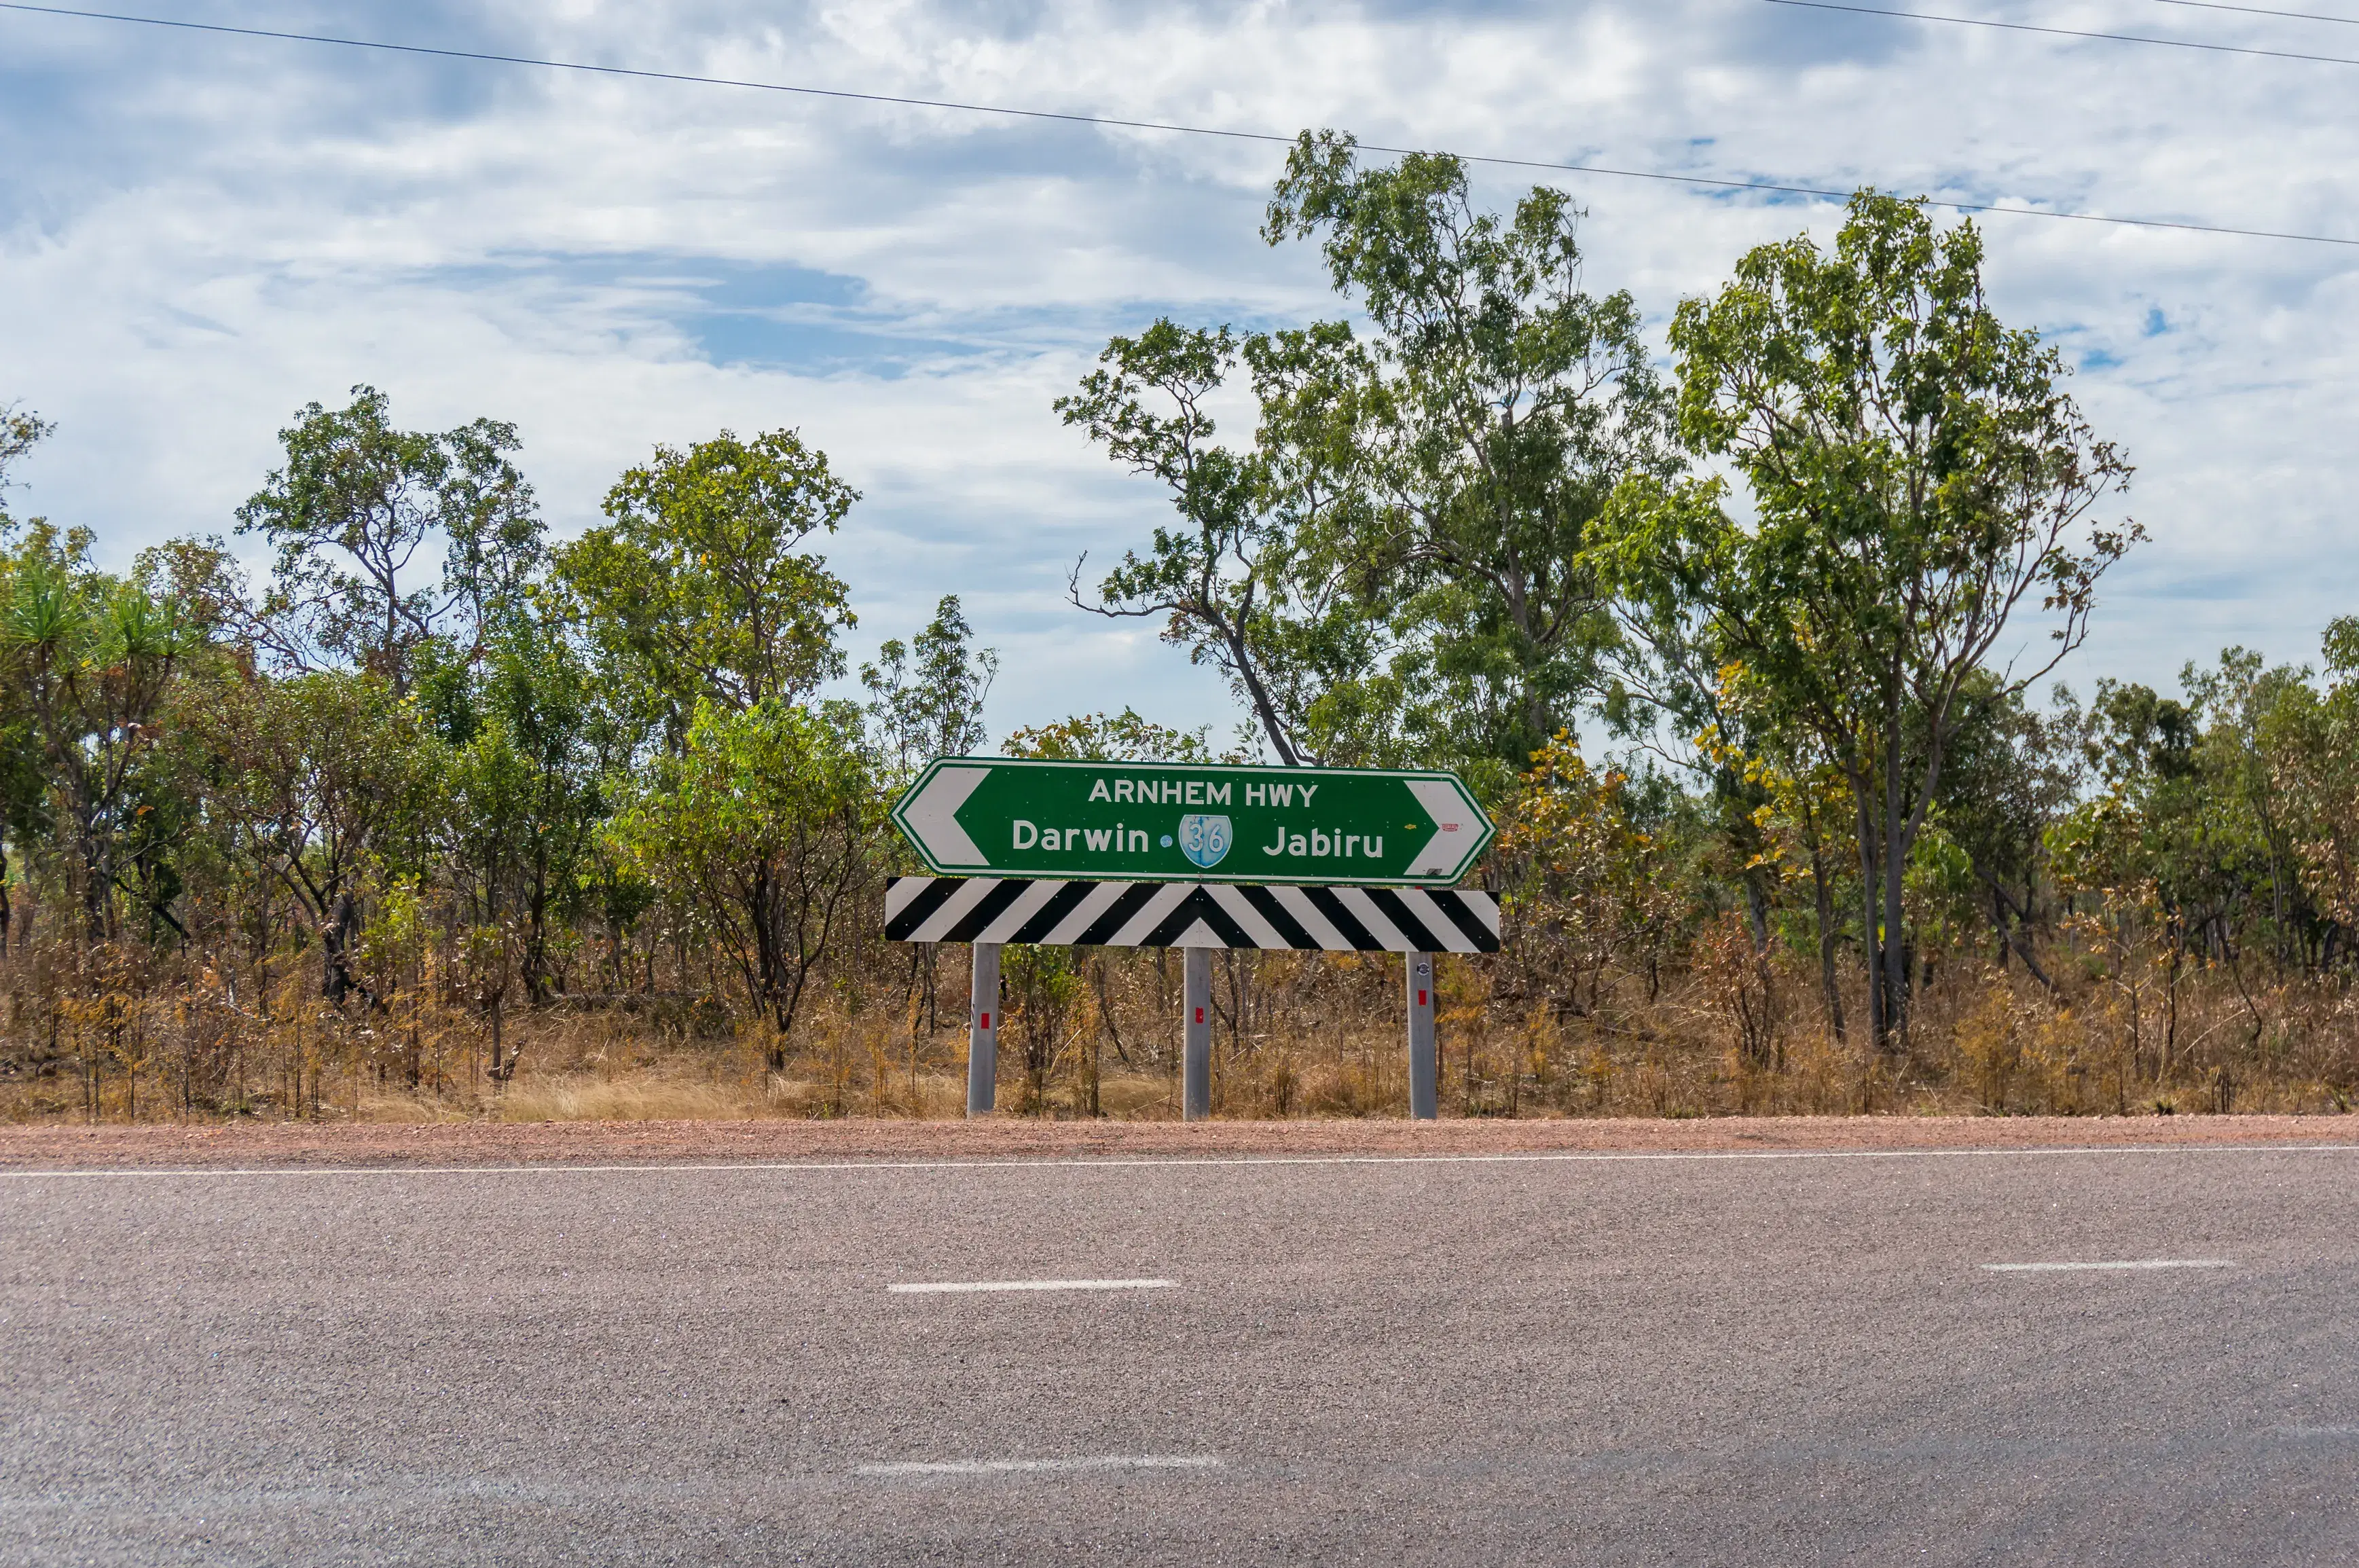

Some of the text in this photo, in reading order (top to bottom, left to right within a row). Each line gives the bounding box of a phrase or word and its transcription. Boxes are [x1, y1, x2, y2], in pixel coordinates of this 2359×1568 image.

[1088, 779, 1319, 807] ARNHEM HWY
[1013, 820, 1148, 852] Darwin
[1188, 823, 1224, 852] 36
[1262, 826, 1383, 858] Jabiru
